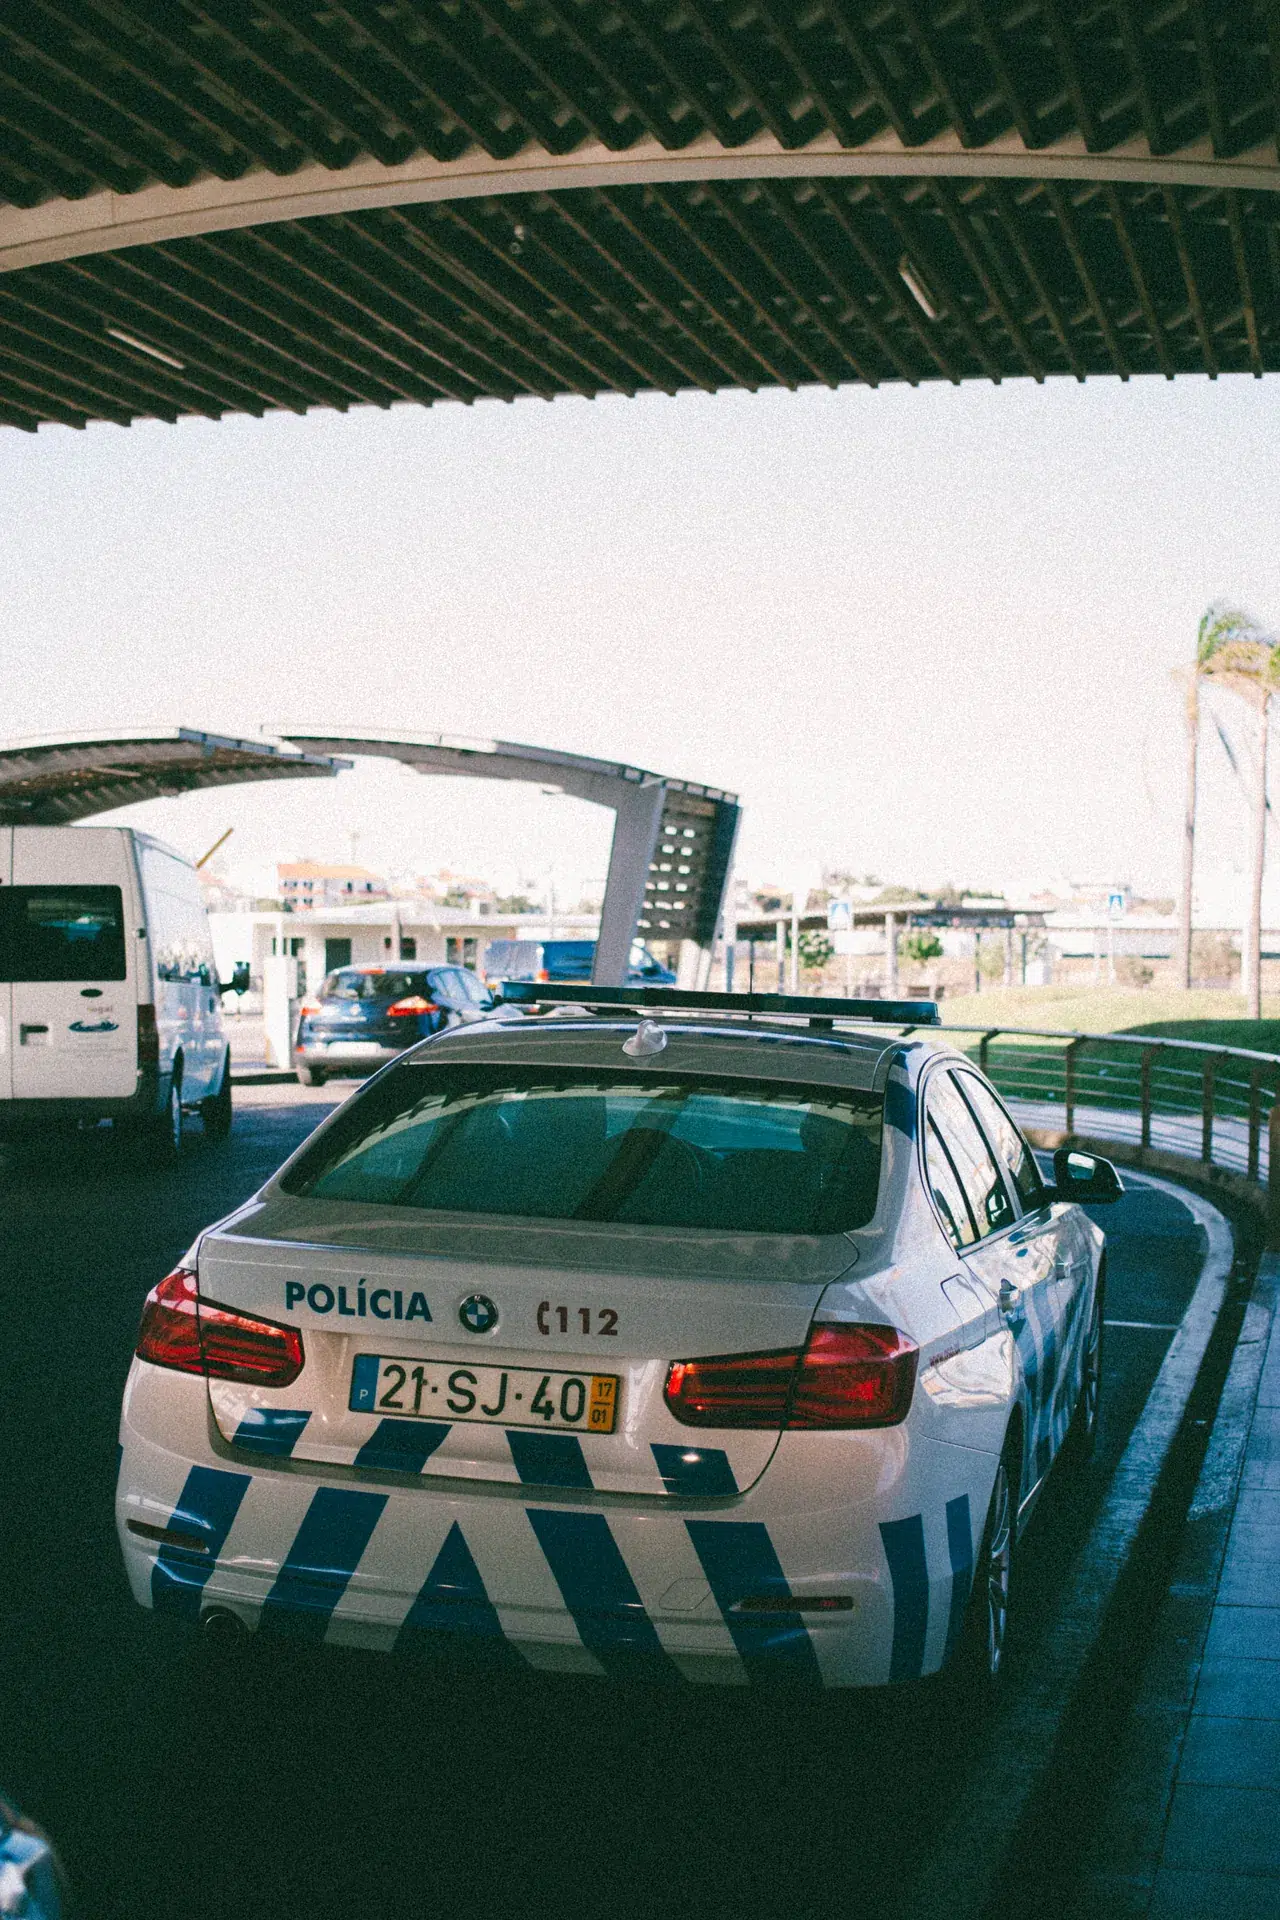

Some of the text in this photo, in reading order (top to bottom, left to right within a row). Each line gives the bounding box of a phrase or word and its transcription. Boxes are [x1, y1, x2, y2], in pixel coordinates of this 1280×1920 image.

[285, 1278, 433, 1322] POLÍCIA
[555, 1306, 619, 1336] 112
[359, 1388, 368, 1400] P
[598, 1382, 612, 1397] 17
[591, 1409, 607, 1424] 01
